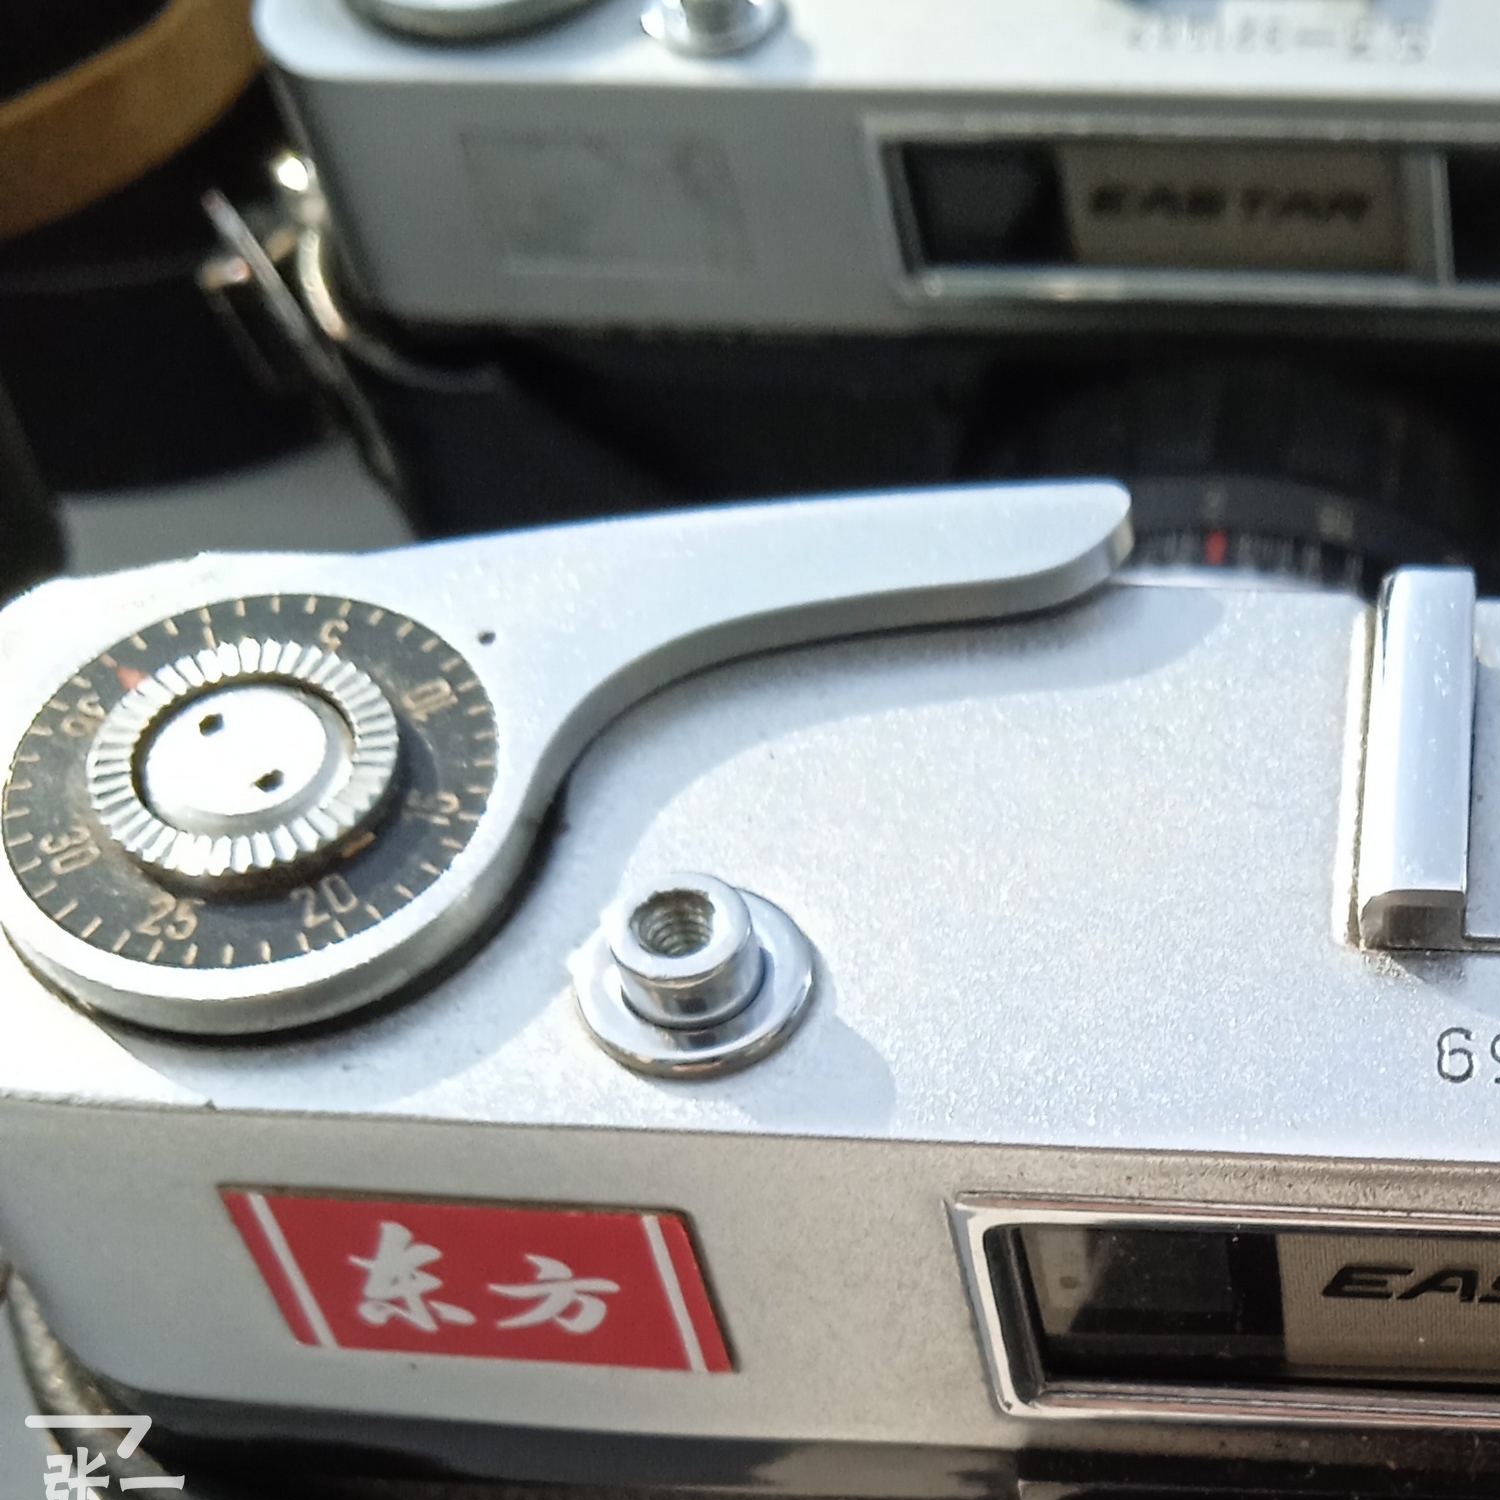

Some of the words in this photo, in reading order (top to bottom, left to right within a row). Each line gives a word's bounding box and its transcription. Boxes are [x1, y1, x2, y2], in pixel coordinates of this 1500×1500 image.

[403, 677, 459, 722] 10
[39, 828, 101, 875] 30
[137, 899, 199, 941] 25
[291, 875, 358, 928] 20
[348, 1220, 621, 1335] 东方
